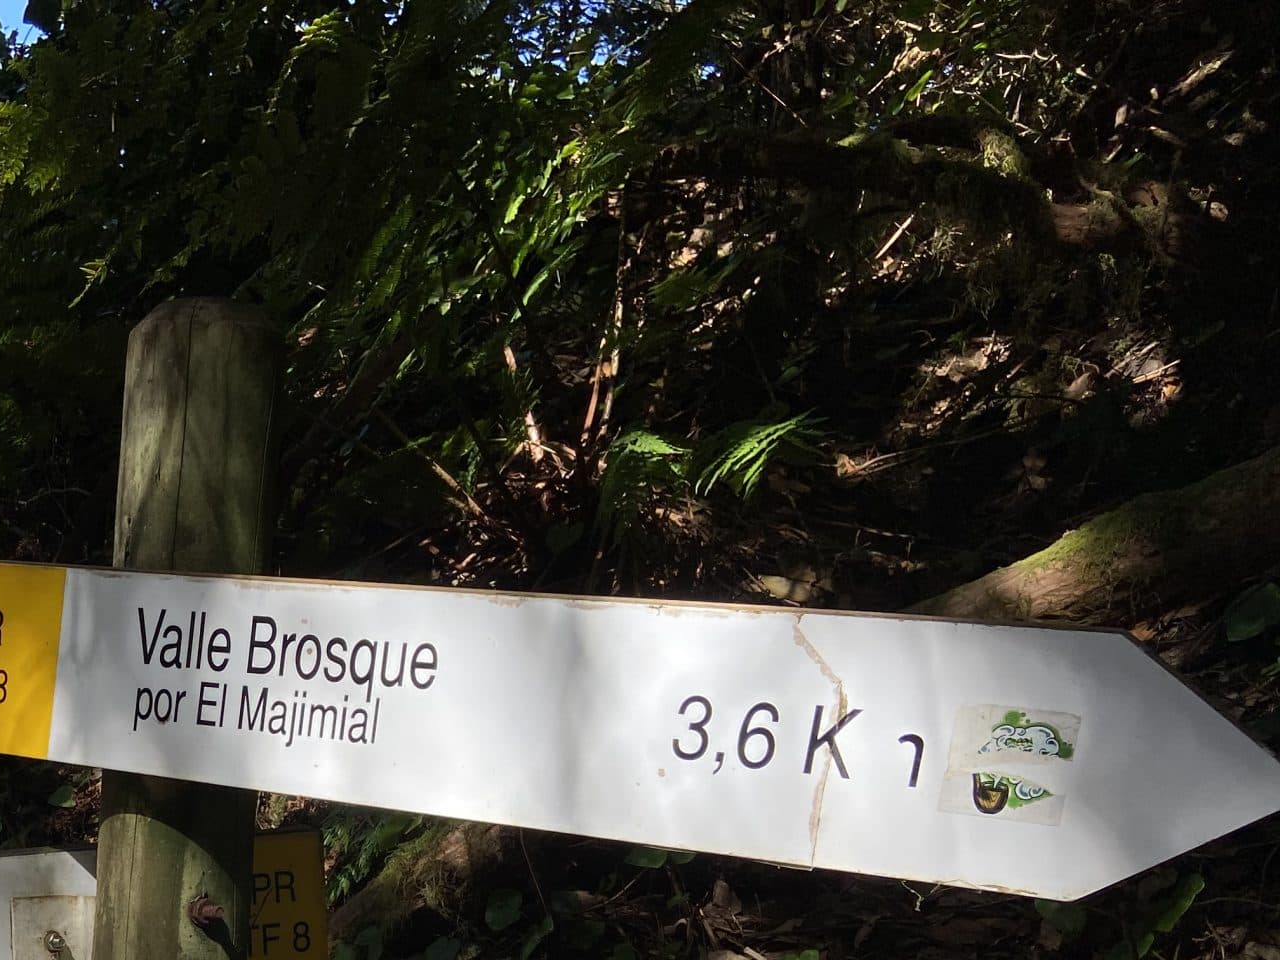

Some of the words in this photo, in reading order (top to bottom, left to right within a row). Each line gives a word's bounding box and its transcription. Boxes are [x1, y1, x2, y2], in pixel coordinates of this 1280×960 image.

[137, 606, 232, 671] Valle
[247, 615, 439, 703] Brosque
[133, 684, 187, 731] por
[196, 681, 225, 727] El
[238, 686, 381, 747] Majimial
[672, 695, 779, 774] 3,6
[252, 870, 297, 905] PR
[292, 920, 312, 953] 8
